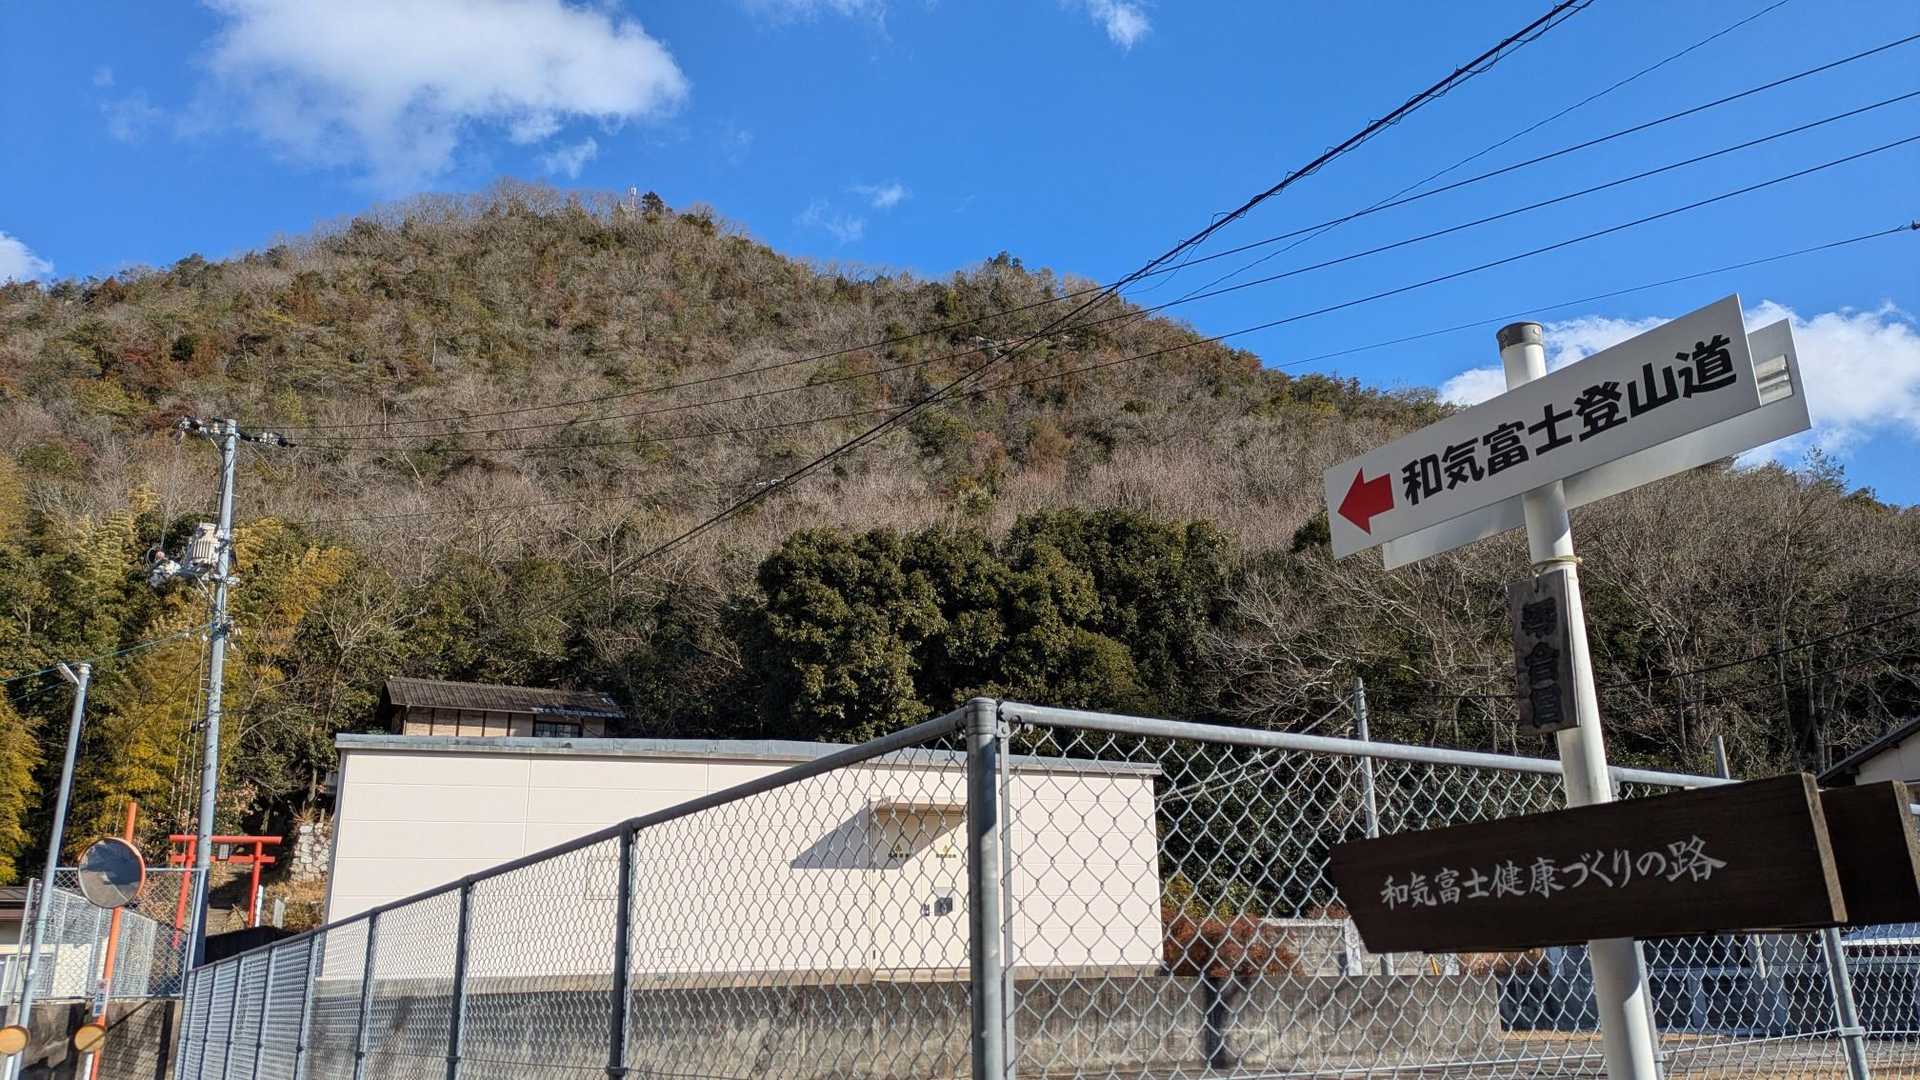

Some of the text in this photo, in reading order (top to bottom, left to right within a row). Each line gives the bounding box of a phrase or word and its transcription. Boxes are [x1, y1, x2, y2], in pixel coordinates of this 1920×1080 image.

[1402, 334, 1737, 506] 和気富士登山道
[1380, 834, 1727, 910] 和気富士健康づくりの路
